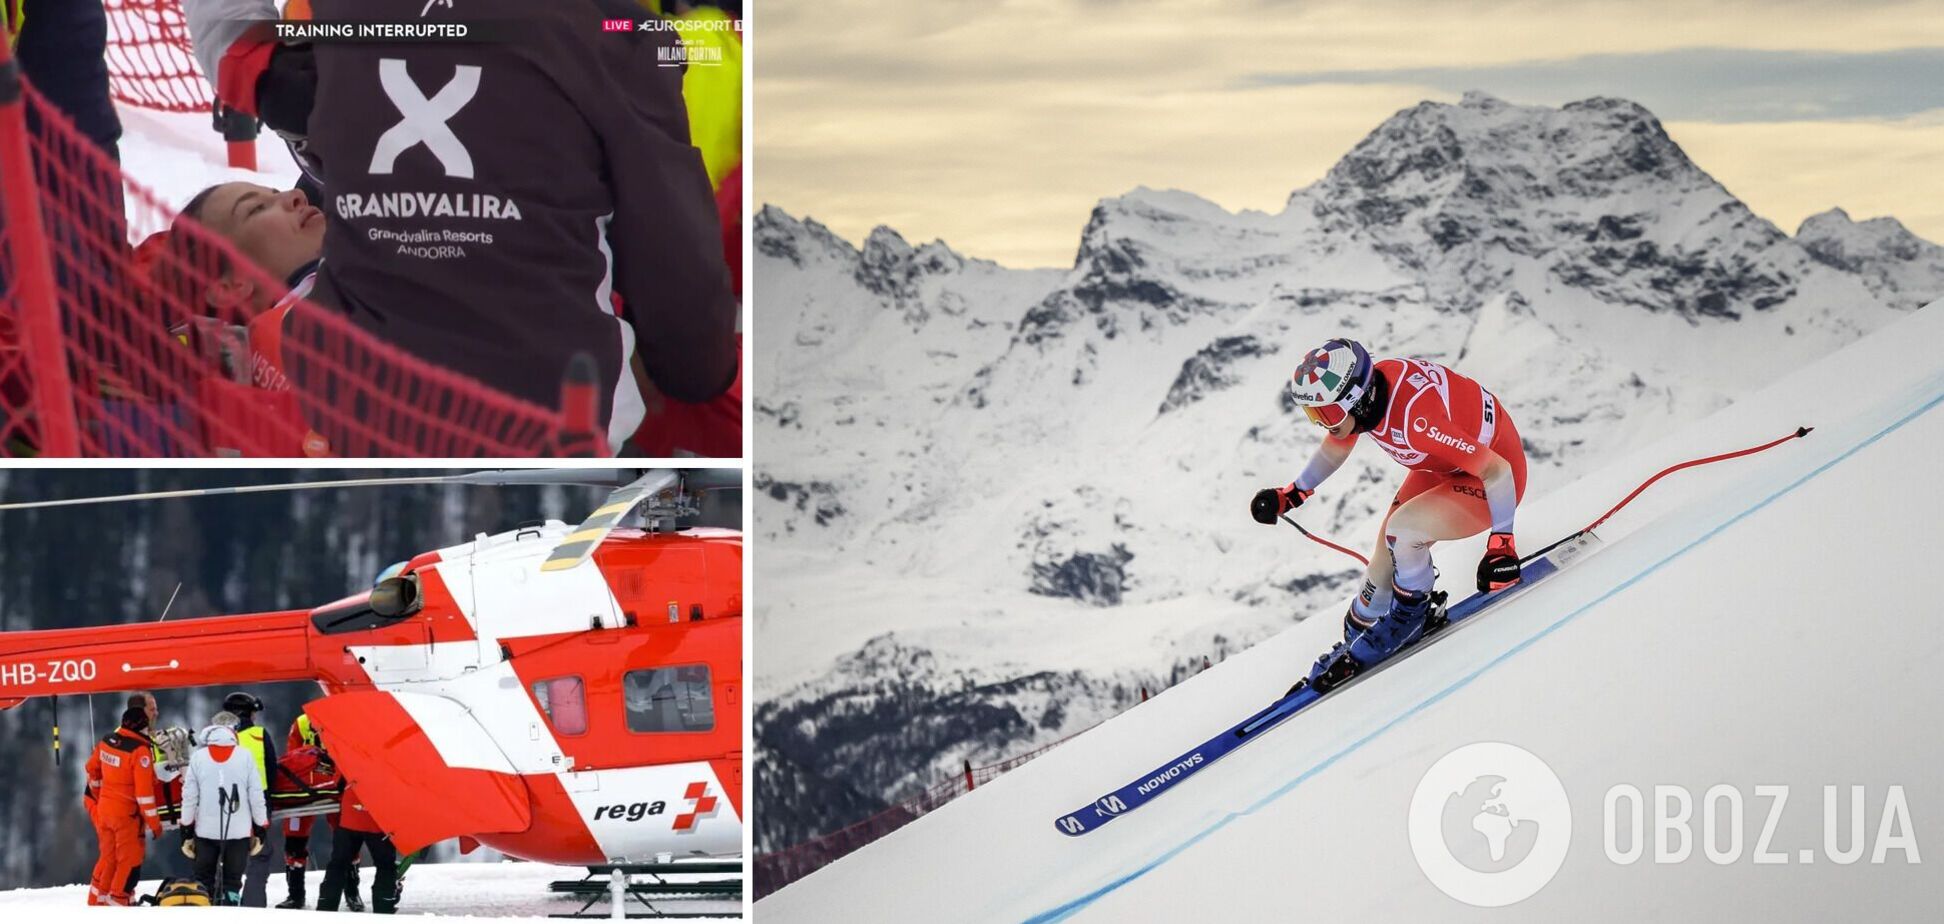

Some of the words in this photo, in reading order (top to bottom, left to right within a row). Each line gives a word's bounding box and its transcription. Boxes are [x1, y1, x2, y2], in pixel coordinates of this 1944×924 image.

[336, 191, 522, 221] GRANDVALIRA
[368, 227, 441, 244] Grandvalira
[442, 229, 493, 244] Resorts
[396, 244, 466, 259] ANDORRA
[1426, 426, 1476, 454] Sunrise
[1, 658, 96, 687] HB-ZQO
[1137, 752, 1204, 796] SALOMON
[593, 800, 667, 822] rega
